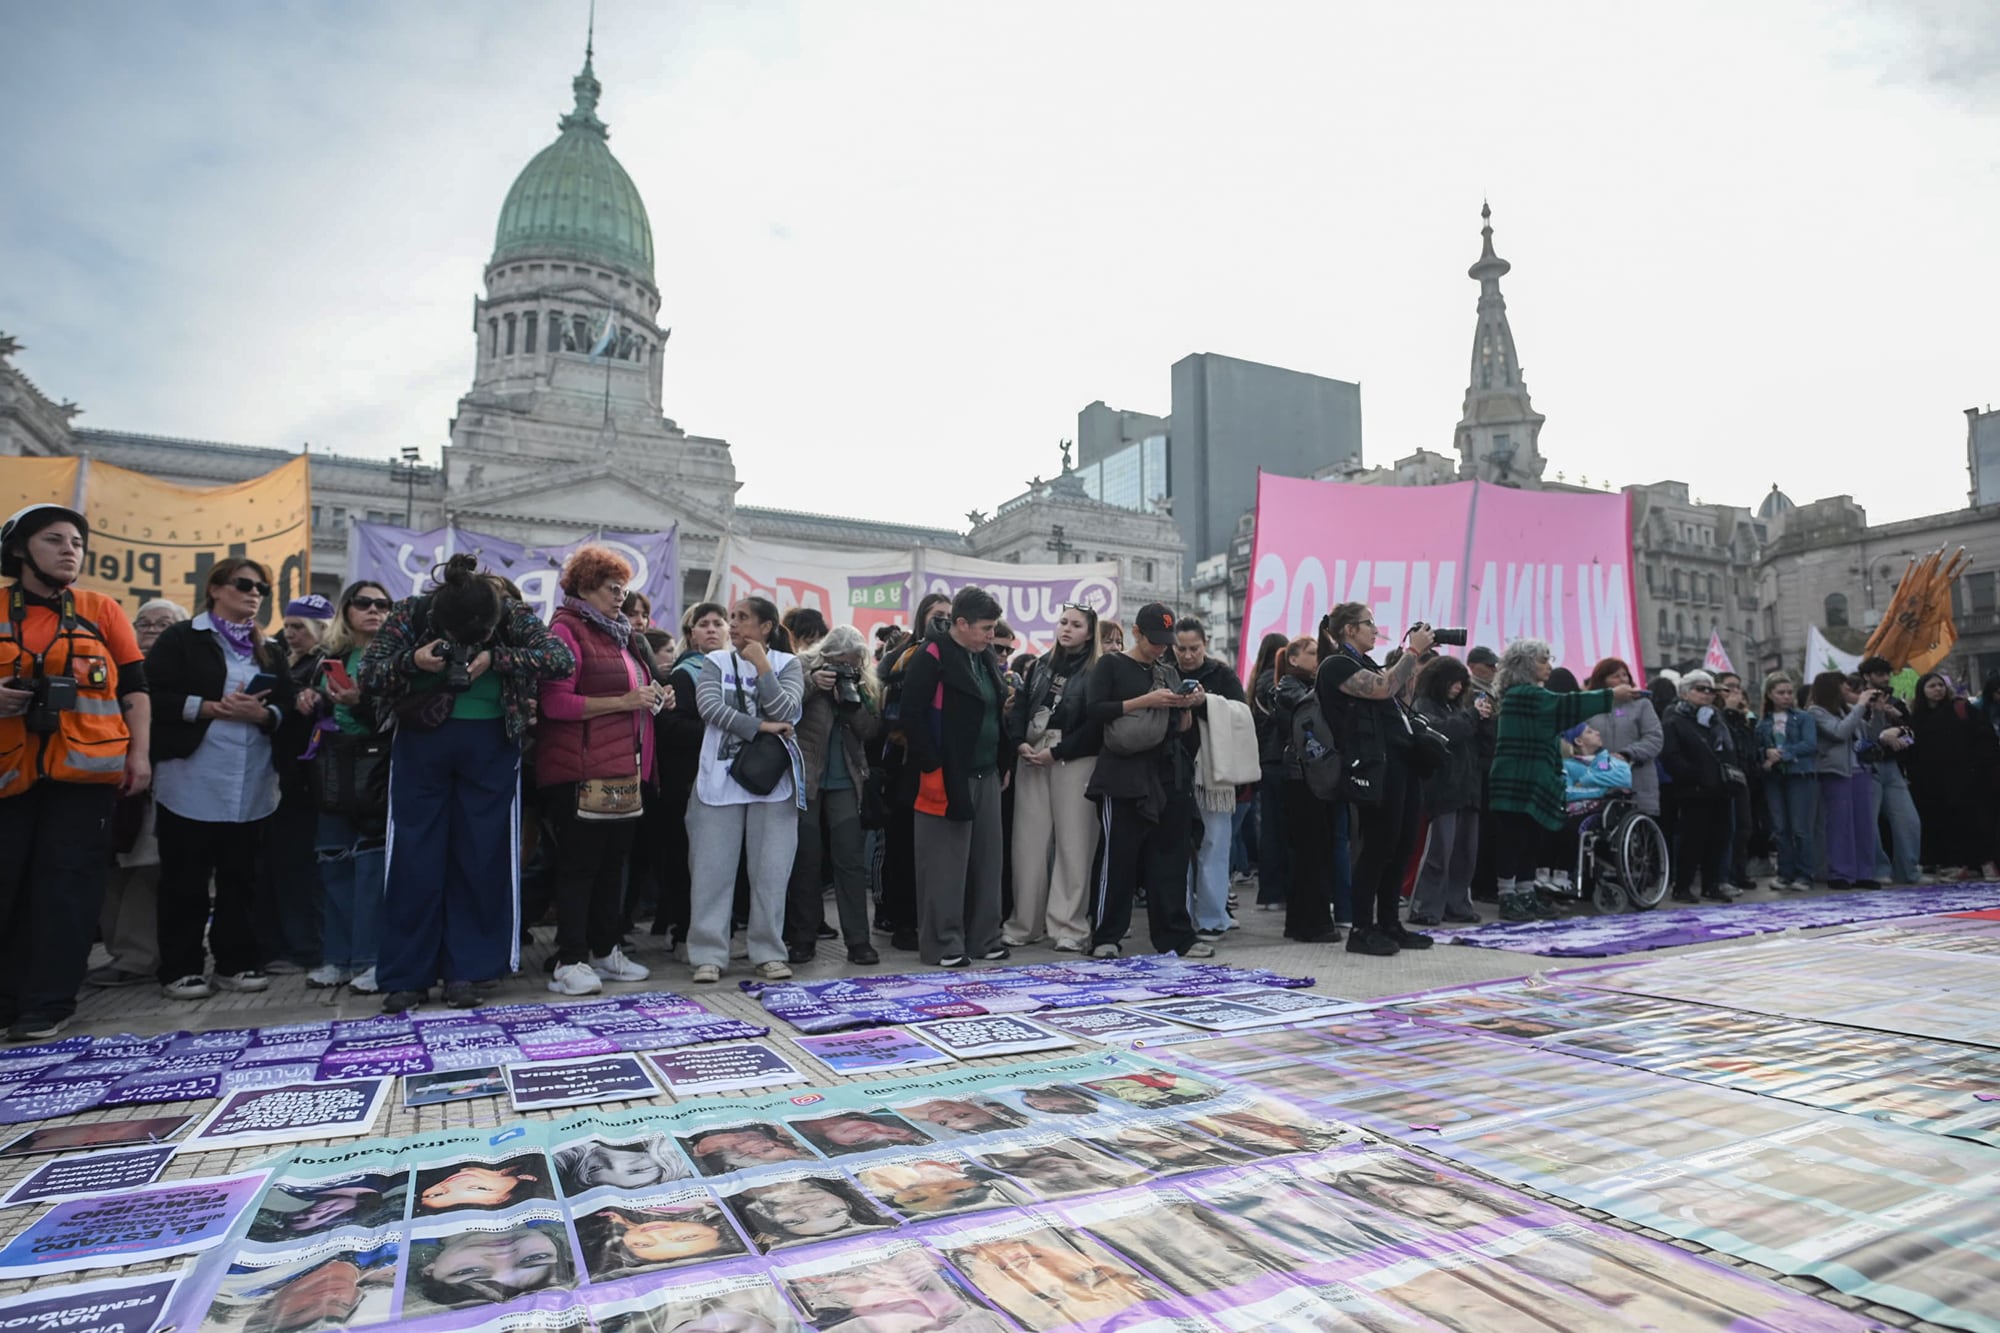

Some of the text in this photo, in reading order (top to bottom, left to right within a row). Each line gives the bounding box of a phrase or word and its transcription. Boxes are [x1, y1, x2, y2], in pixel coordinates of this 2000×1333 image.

[818, 1043, 926, 1059] FEMICIDIO
[819, 1035, 897, 1048] EXISTE
[665, 1055, 744, 1067] VIOLENCIA
[225, 1066, 312, 1086] VALLEJOS
[519, 1065, 620, 1078] VIOLENCIA
[515, 1075, 641, 1094] JUSTIFIQUES
[567, 1086, 598, 1095] NO
[45, 1160, 156, 1179] PERO SIEMPRE
[49, 1153, 160, 1173] SON HOMBRES
[26, 1173, 148, 1194] NO SON TODOS
[44, 1166, 156, 1186] LOS HOMBRES
[165, 1189, 219, 1200] CADA
[55, 1202, 227, 1229] MIENTRAS HAY UN
[70, 1193, 229, 1221] FEMICIDIO
[166, 1214, 189, 1223] DE
[32, 1213, 226, 1245] NIEGA LA VIOLENCIA
[171, 1222, 208, 1237] EL
[31, 1230, 162, 1254] ESTADO
[35, 1312, 101, 1331] HAY
